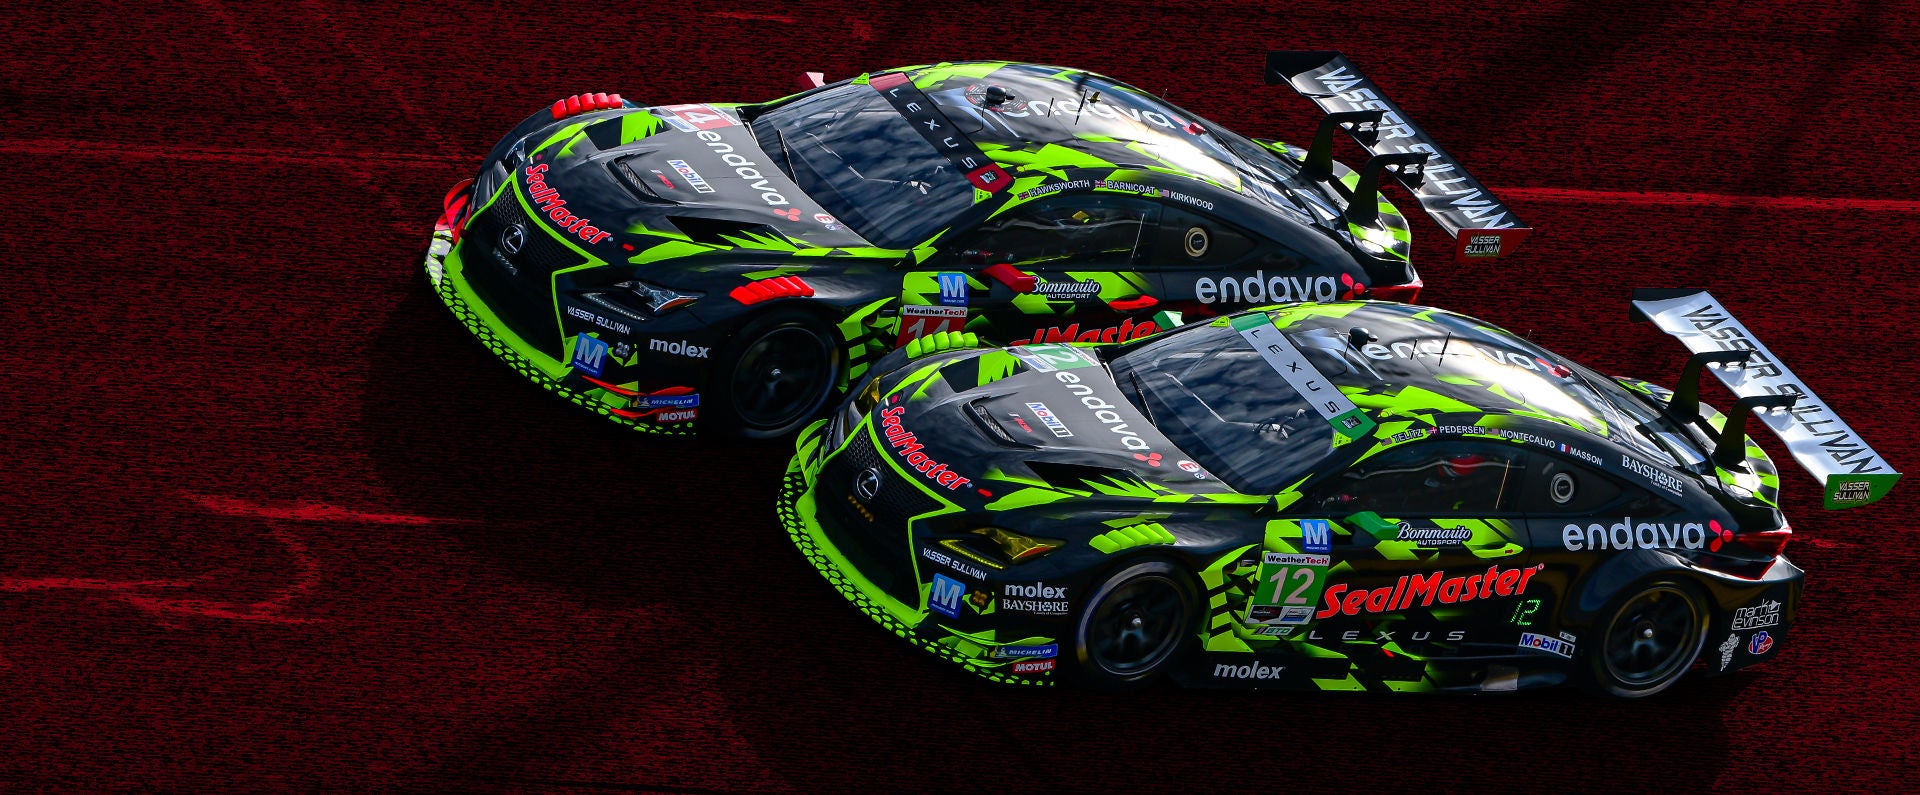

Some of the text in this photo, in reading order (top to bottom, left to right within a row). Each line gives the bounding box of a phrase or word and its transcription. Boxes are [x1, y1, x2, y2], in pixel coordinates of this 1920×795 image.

[890, 88, 978, 169] LEXUS
[670, 161, 703, 184] Mobil
[697, 131, 789, 206] endava
[1030, 180, 1090, 196] HAWKSWORTH
[1107, 180, 1155, 194] BARNICOAT
[1170, 191, 1213, 211] KIRKWOOD
[1464, 245, 1500, 253] SULLIVAN
[1470, 235, 1500, 244] VASSER
[942, 276, 965, 298] M
[1195, 269, 1337, 304] endava
[567, 305, 630, 335] VASSER SULLIVAN
[906, 307, 965, 316] WeatherTech
[576, 338, 603, 369] M
[650, 338, 709, 359] molex
[1361, 339, 1541, 372] endva
[1251, 329, 1340, 413] LEXUS
[658, 410, 696, 421] MOTUL
[1028, 403, 1062, 427] Mobil
[1056, 371, 1151, 450] endava
[1393, 428, 1423, 442] TELITZ
[1439, 425, 1485, 435] PEDERSEN
[1500, 429, 1556, 449] MONTECALVO
[1570, 447, 1602, 466] MASSON
[1622, 454, 1682, 492] BAYSHORE
[1834, 491, 1870, 500] SULLIVAN
[1840, 481, 1870, 490] VASSER
[1304, 522, 1328, 545] M
[1397, 520, 1472, 540] Bommarito
[1562, 516, 1706, 551] endava
[923, 547, 987, 581] VASSER SULLIVAN
[1267, 554, 1328, 564] WeatherTech
[933, 578, 960, 610] M
[1005, 582, 1066, 598] molex
[1269, 566, 1315, 604] 12
[1003, 599, 1069, 611] BAYSHORE
[1510, 600, 1540, 625] 12
[1736, 599, 1769, 618] mark
[1308, 630, 1467, 641] LEXUS
[1521, 634, 1559, 652] Mobil
[1008, 648, 1052, 656] MICHELIN
[1015, 662, 1053, 672] MOTUL
[1214, 661, 1283, 679] molex
